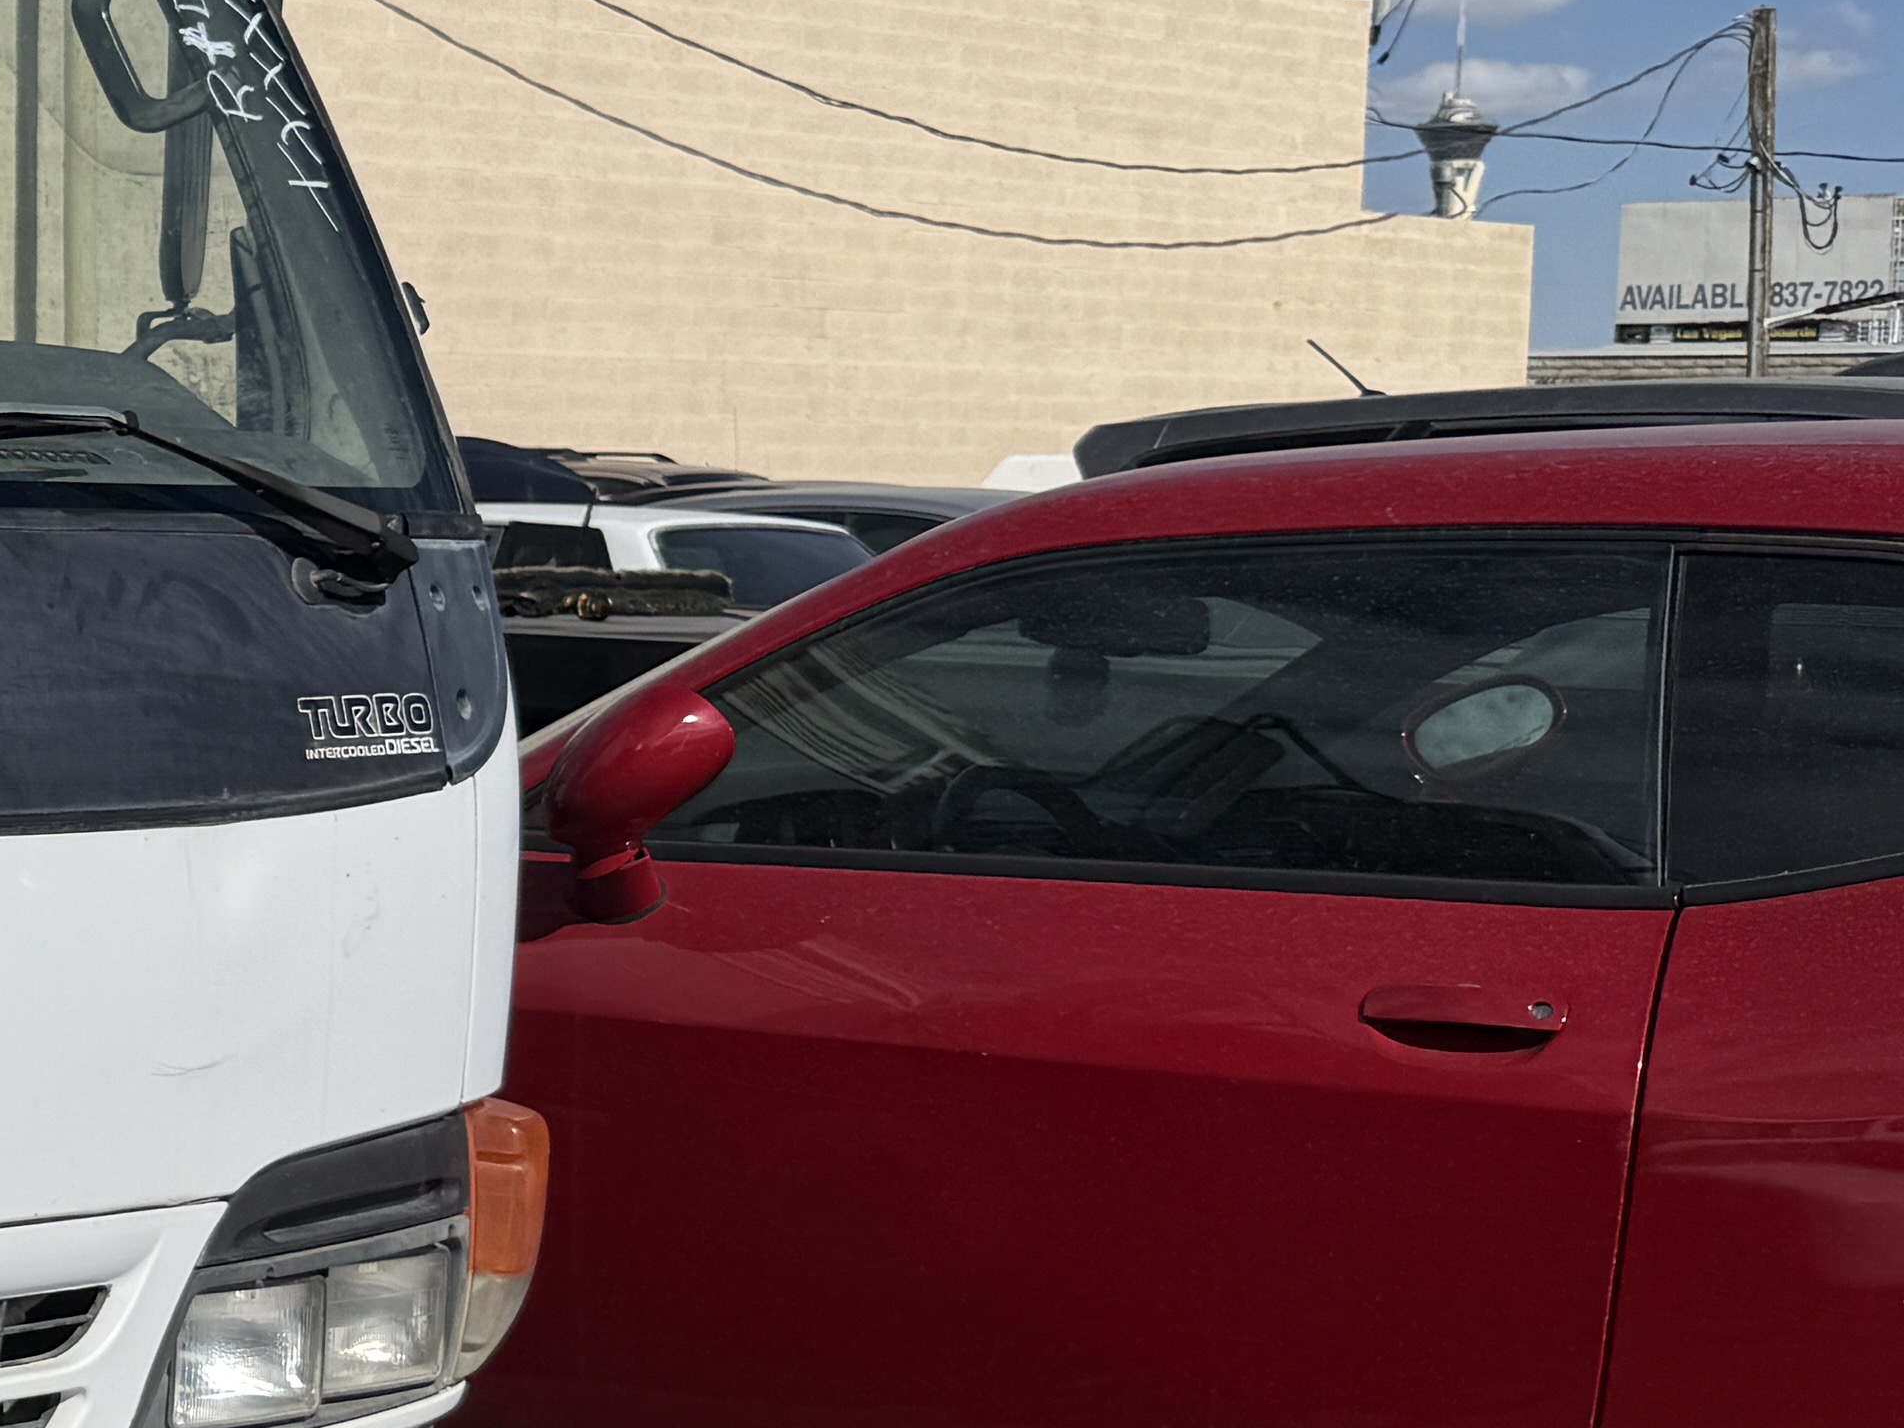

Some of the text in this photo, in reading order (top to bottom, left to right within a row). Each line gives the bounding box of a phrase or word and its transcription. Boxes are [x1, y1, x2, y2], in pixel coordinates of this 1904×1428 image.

[1620, 284, 1748, 310] AVAILABL
[297, 693, 434, 740] TURBO
[306, 736, 440, 760] INTERCOOLED DIESEL
